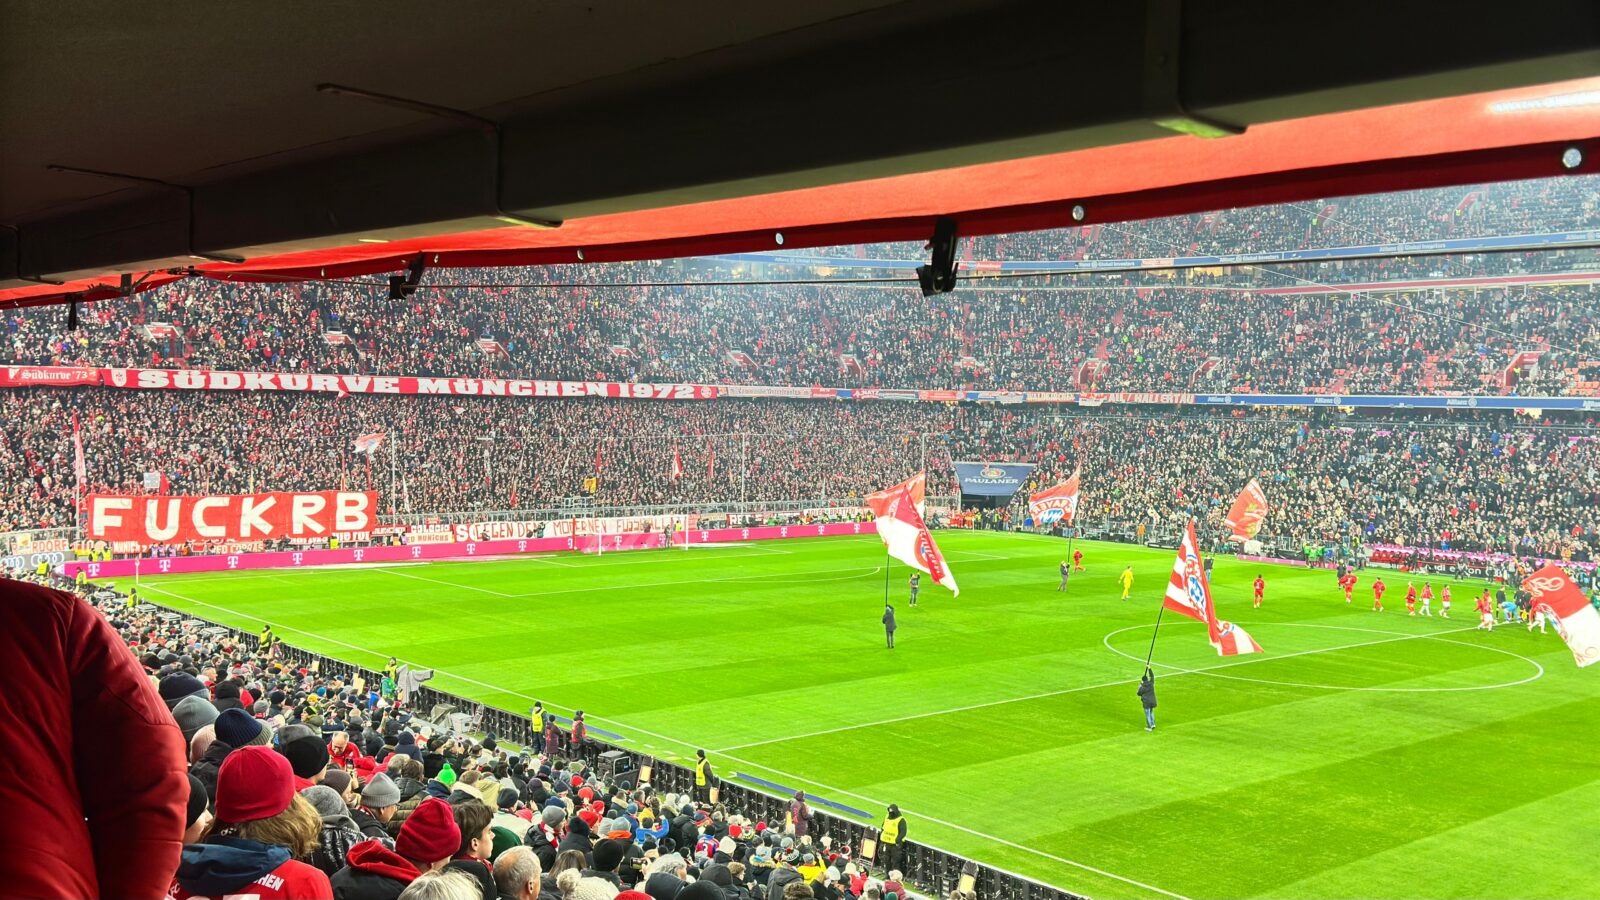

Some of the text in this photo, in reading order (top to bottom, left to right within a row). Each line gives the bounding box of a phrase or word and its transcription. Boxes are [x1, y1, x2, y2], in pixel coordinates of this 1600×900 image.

[21, 369, 70, 380] Südkurve
[138, 369, 695, 399] SÜDKURVE MÜNCHEN 1972
[93, 492, 369, 541] FUCK RB
